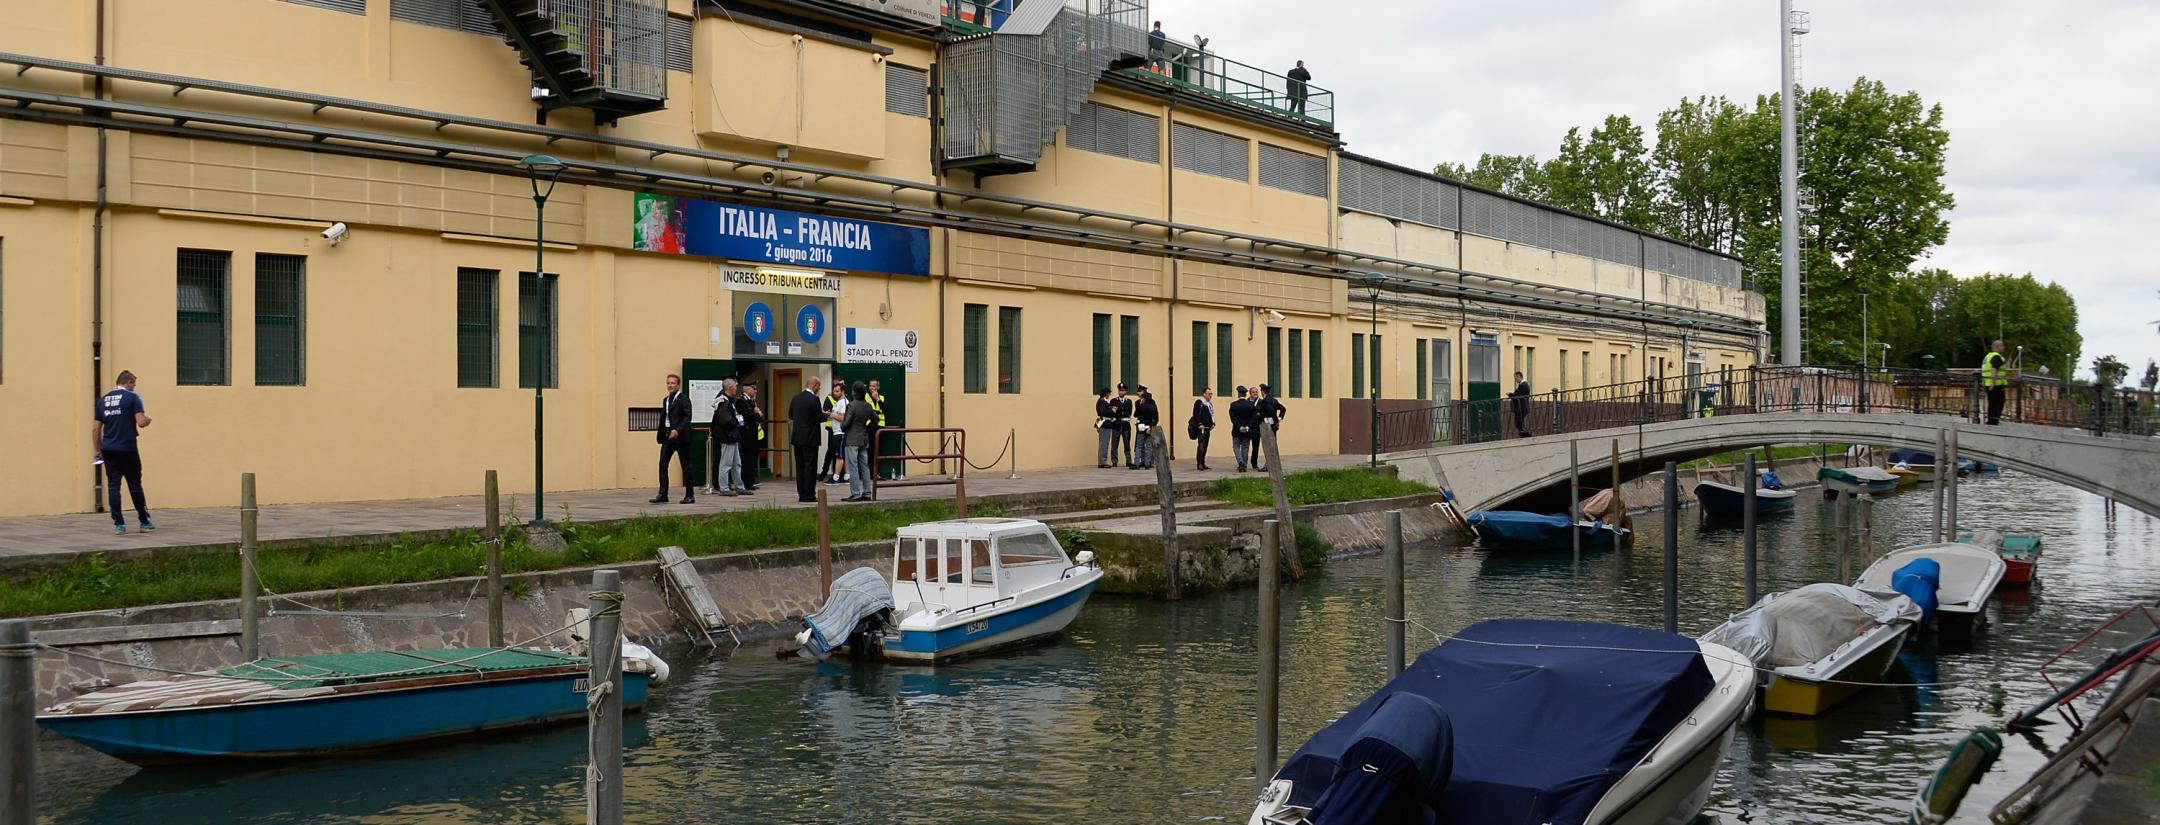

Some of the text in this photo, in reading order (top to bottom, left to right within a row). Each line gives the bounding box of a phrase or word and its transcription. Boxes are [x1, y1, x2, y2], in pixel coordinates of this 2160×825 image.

[894, 4, 912, 14] COMUNE
[918, 11, 935, 20] VENEZIA
[719, 207, 778, 241] ITALIA
[798, 217, 872, 251] FRANCIA
[765, 243, 833, 263] 2 giugno 2016
[723, 270, 840, 291] INGRESSO TRIBUNA CENTRALE
[847, 348, 914, 358] STADIO P.L. PENZO
